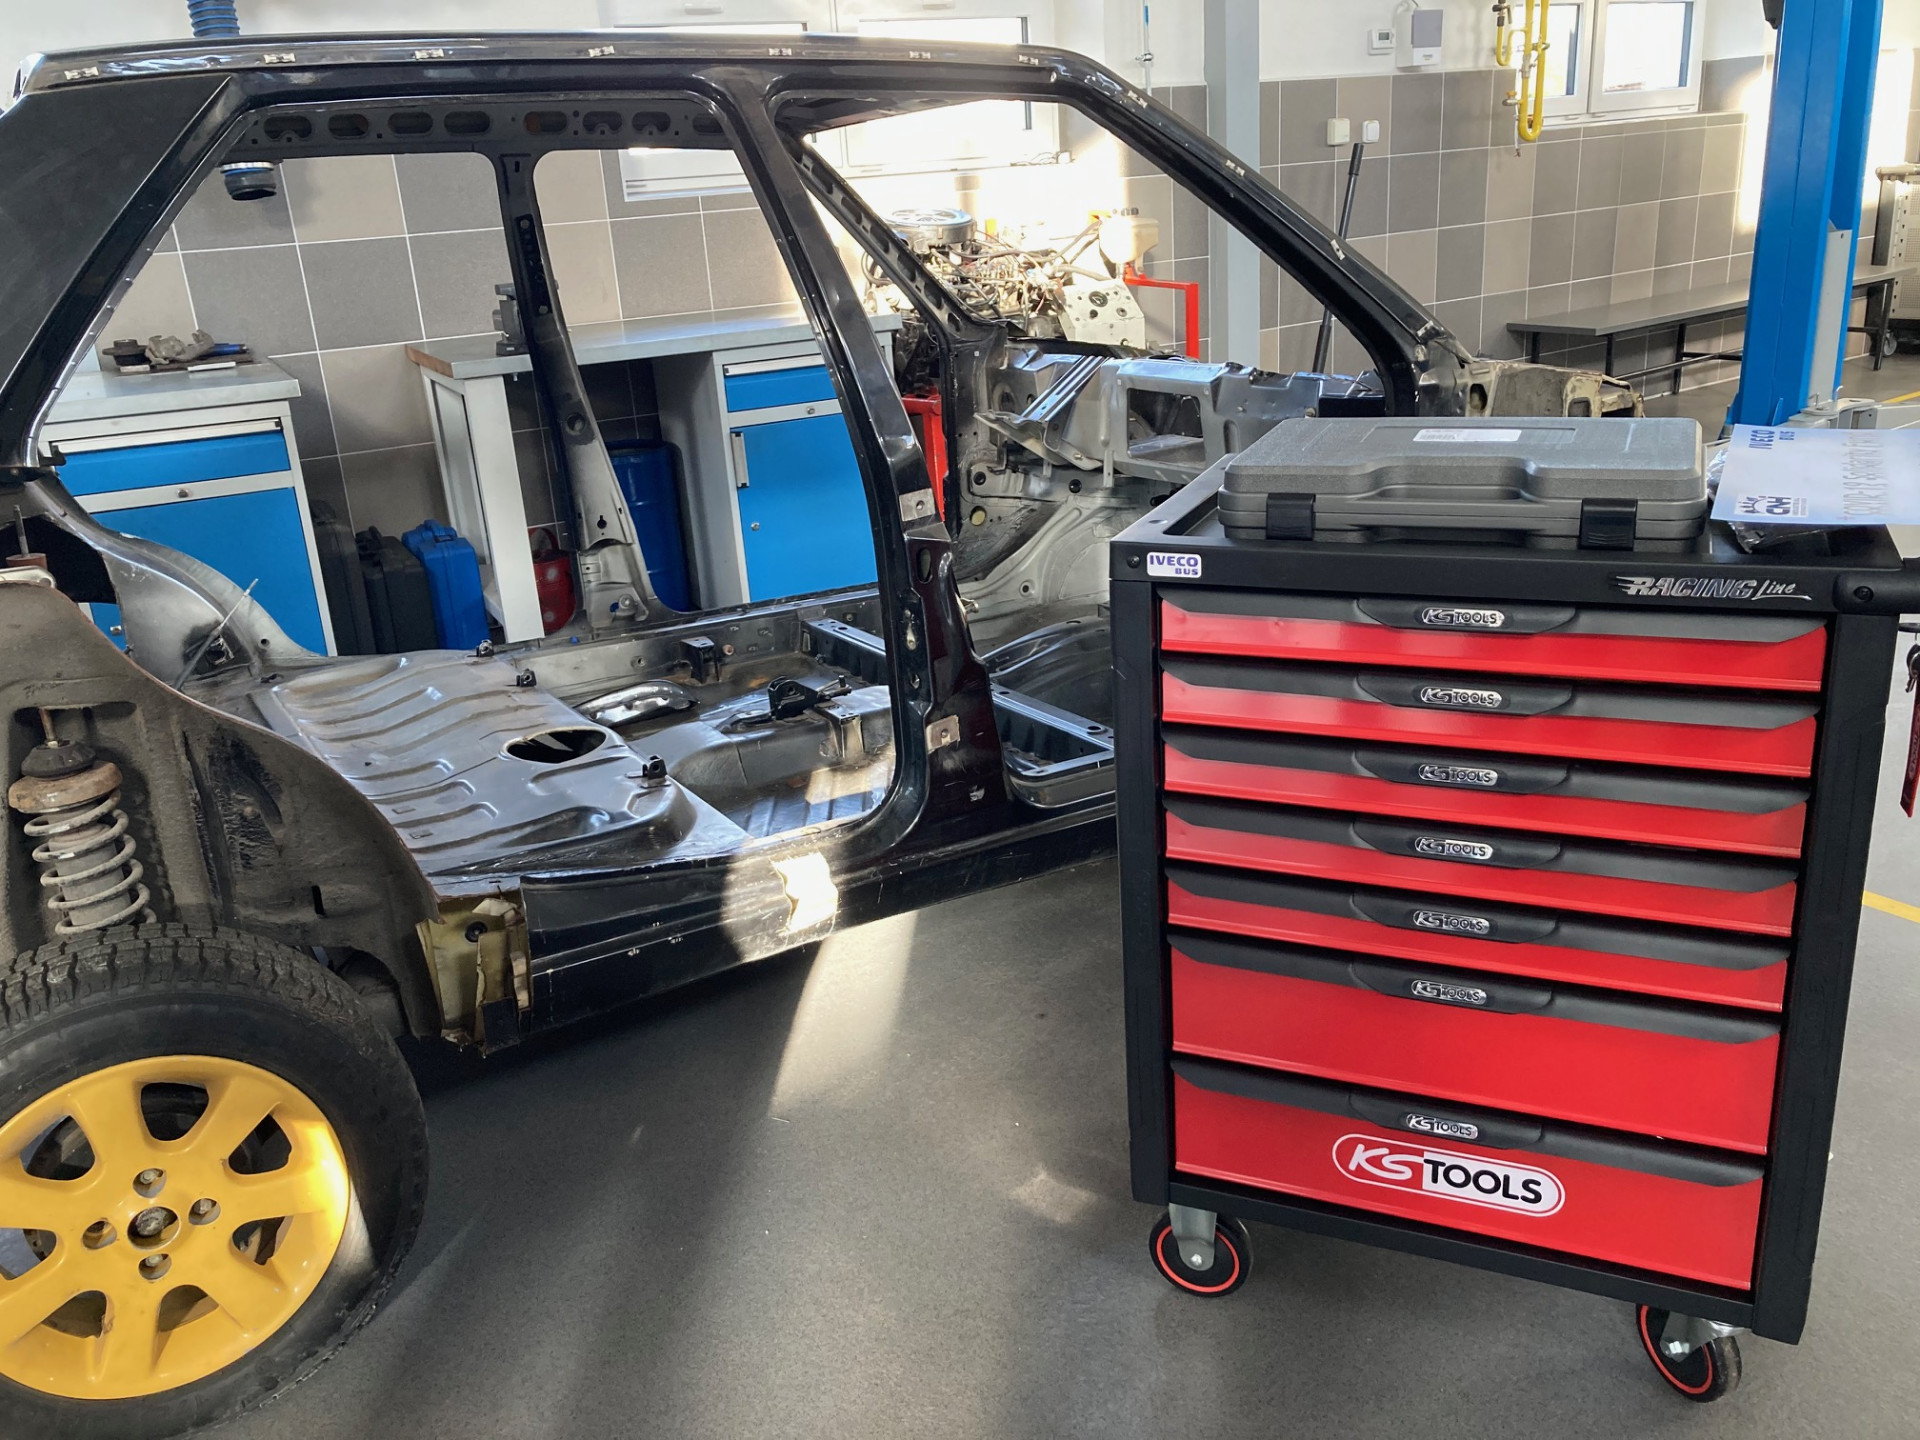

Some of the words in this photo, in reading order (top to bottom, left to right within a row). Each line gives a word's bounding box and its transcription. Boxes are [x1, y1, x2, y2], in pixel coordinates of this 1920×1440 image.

[1749, 429, 1775, 449] IVECO
[1766, 496, 1792, 515] CNH
[1149, 555, 1198, 567] IVECO
[1175, 567, 1198, 576] BUS
[1616, 575, 1757, 600] RACING
[1752, 579, 1798, 600] Line
[1348, 1143, 1423, 1180] KS
[1423, 1158, 1542, 1204] TOOLS
